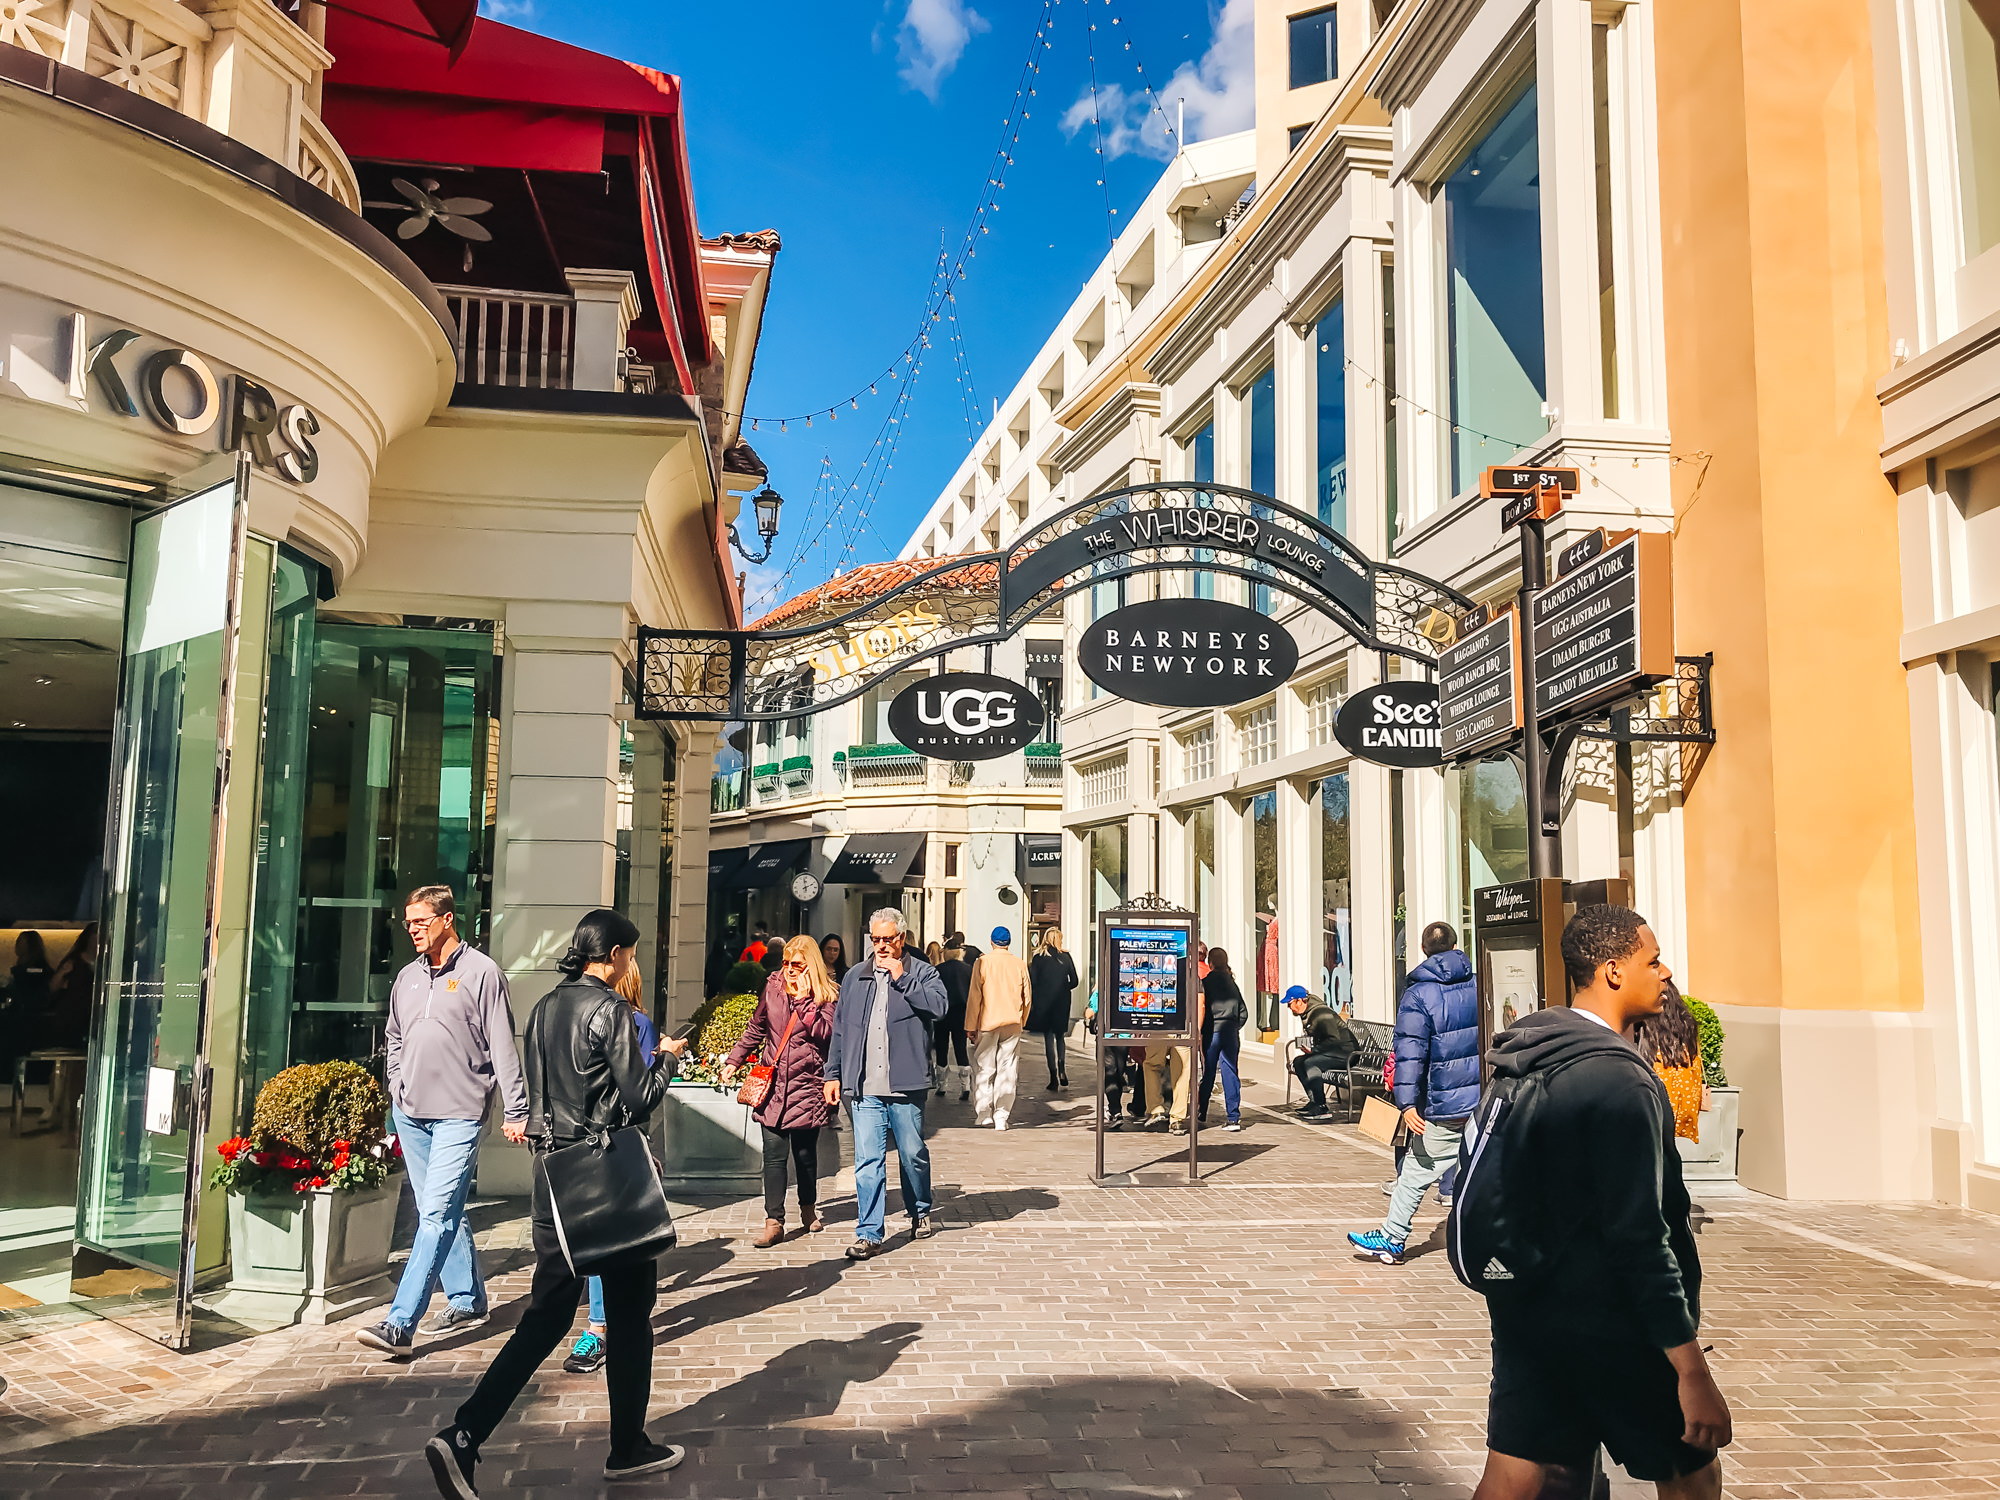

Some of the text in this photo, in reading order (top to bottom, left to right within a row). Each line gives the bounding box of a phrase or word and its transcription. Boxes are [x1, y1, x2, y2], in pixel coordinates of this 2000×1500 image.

[68, 312, 321, 483] KORS
[1083, 507, 1327, 574] THE WHISPER LOUNGE
[1541, 554, 1625, 616] BARNEYS NEW YORK
[1551, 596, 1612, 639] UGG AUSTRALIA
[808, 598, 942, 684] SHOPS
[1105, 629, 1271, 651] BARNEYS
[1453, 634, 1491, 665] MAGGIANO'S
[1552, 627, 1612, 669] UMAMI BURGER
[1447, 655, 1501, 693] WOOD RANCH BBQ
[1548, 655, 1619, 701] BRANDY MELVILLE
[916, 688, 1017, 735] UGG
[1449, 683, 1500, 718] WHISPER LOUNGE
[917, 736, 1018, 745] australia
[1454, 714, 1495, 743] SEE'S CANDIES
[1030, 851, 1062, 862] J.CREW
[1482, 1271, 1515, 1280] adidas
